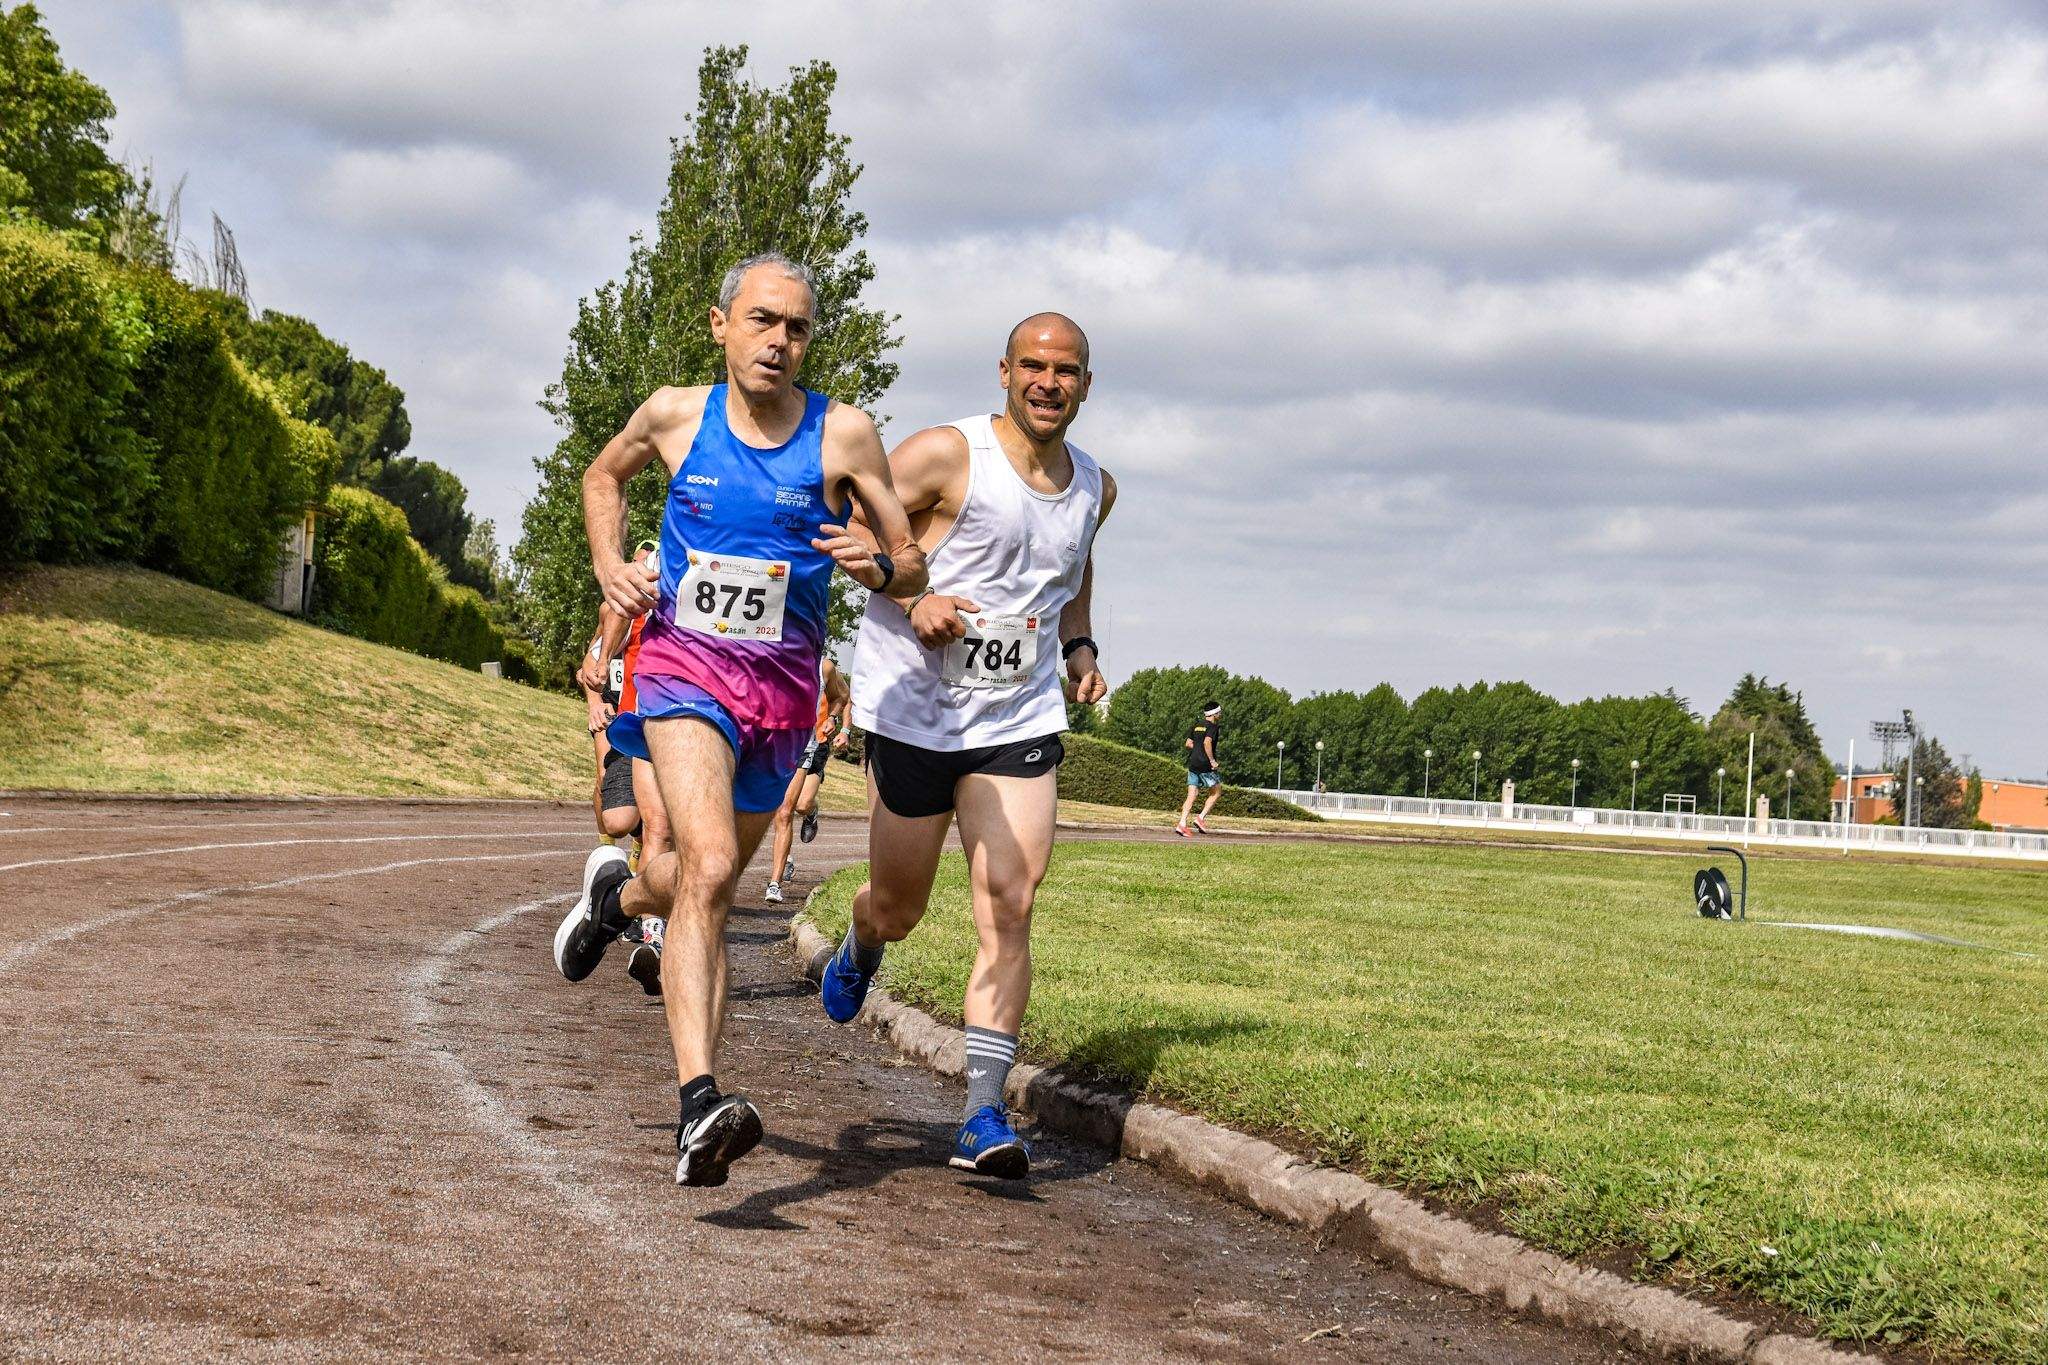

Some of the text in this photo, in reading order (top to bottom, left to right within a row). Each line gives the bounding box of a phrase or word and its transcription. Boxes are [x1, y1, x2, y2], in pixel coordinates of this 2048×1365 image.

[695, 580, 767, 621] 875
[755, 626, 776, 635] 2023
[963, 637, 1021, 671] 784
